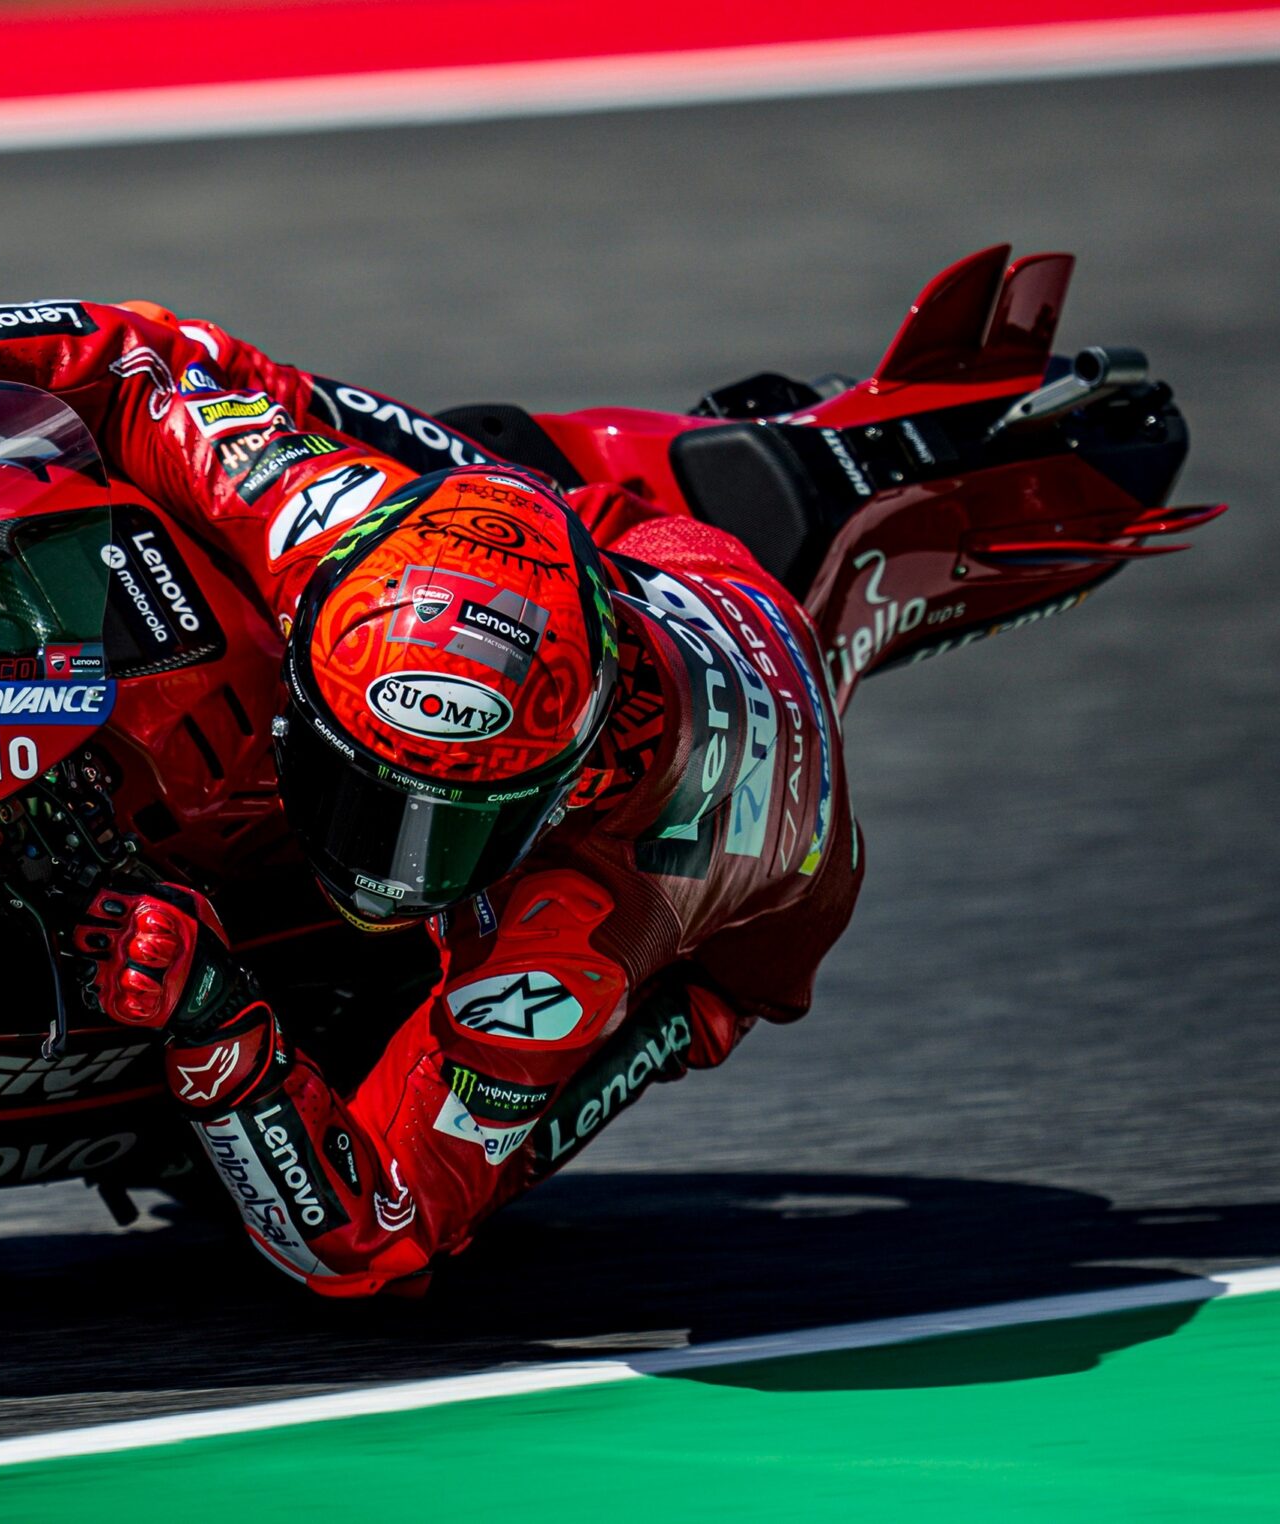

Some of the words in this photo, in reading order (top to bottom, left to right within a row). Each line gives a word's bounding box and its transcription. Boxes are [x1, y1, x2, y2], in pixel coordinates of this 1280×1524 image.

[336, 387, 486, 466] novo
[132, 531, 200, 632] Lenovo
[118, 567, 169, 643] motorola
[465, 605, 530, 645] Lenovo
[72, 658, 101, 666] Lenovo
[382, 681, 500, 735] SUOMY
[314, 718, 355, 759] CARRERA
[779, 690, 803, 805] Audi
[391, 772, 447, 796] MONSTER
[488, 787, 540, 802] CARRERA
[357, 876, 402, 898] FASSI
[477, 1083, 547, 1104] MONSTER
[551, 1016, 691, 1162] Lenovo
[474, 1125, 526, 1155] ello
[253, 1104, 325, 1226] Lenovo
